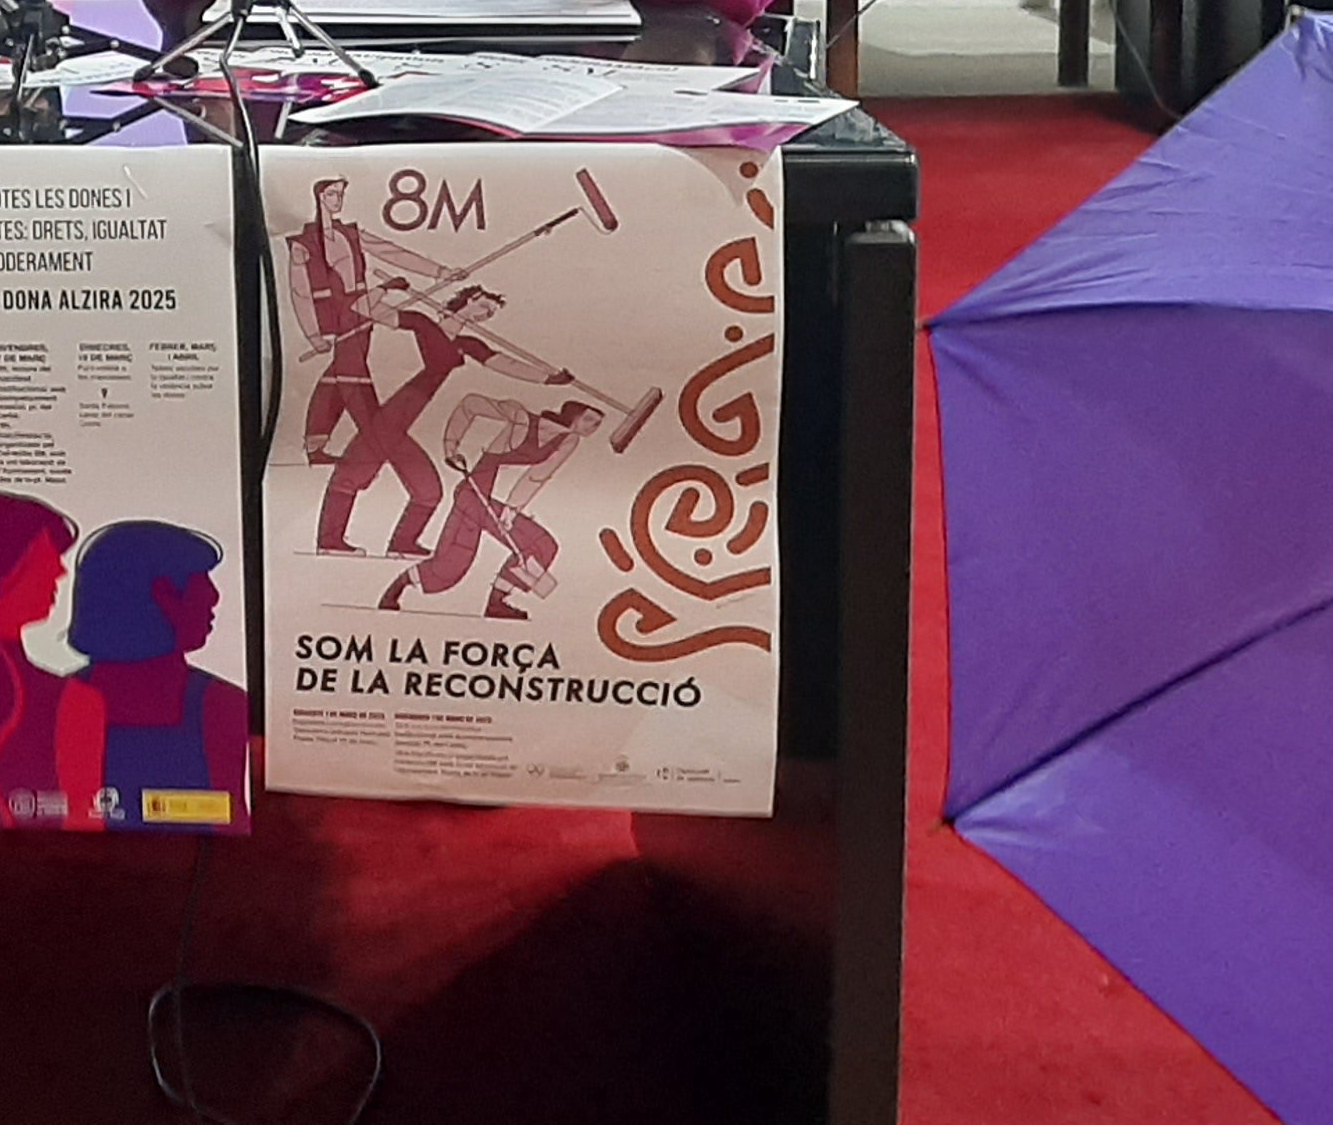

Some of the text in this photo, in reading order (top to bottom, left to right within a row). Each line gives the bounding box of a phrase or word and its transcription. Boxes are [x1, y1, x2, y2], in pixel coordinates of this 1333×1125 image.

[35, 189, 64, 209] LES
[69, 188, 122, 208] DONES
[381, 169, 486, 233] 8M
[32, 220, 88, 241] DRETS,
[92, 219, 167, 240] IGUALTAT
[3, 290, 52, 310] DONA
[59, 290, 123, 310] ALZIRA
[129, 290, 176, 310] 2025
[295, 634, 560, 674] SOM LA FORÇA
[295, 667, 702, 708] DE LA RECONSTRUCCIÓ
